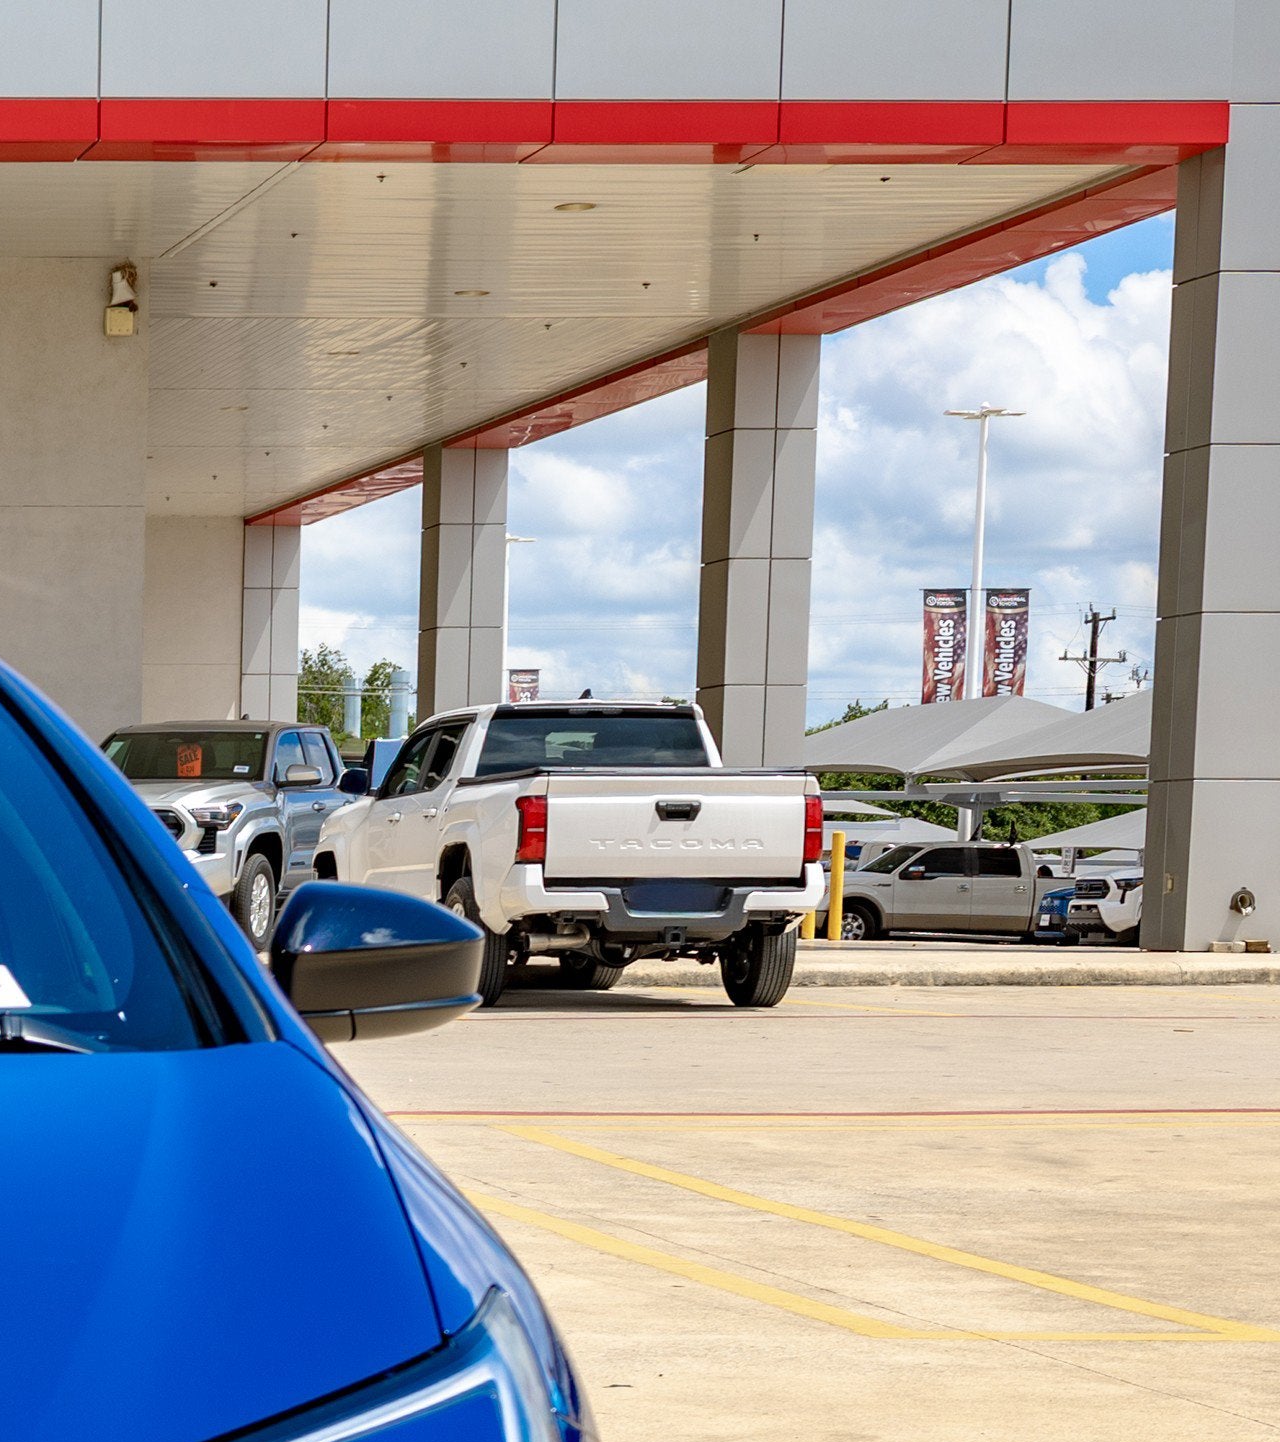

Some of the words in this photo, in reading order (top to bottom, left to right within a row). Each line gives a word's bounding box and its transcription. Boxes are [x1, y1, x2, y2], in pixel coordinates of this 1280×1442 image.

[933, 619, 955, 681] Vehicles
[993, 620, 1017, 682] Vehicles
[935, 683, 952, 702] ew
[589, 838, 766, 850] TACOMA
